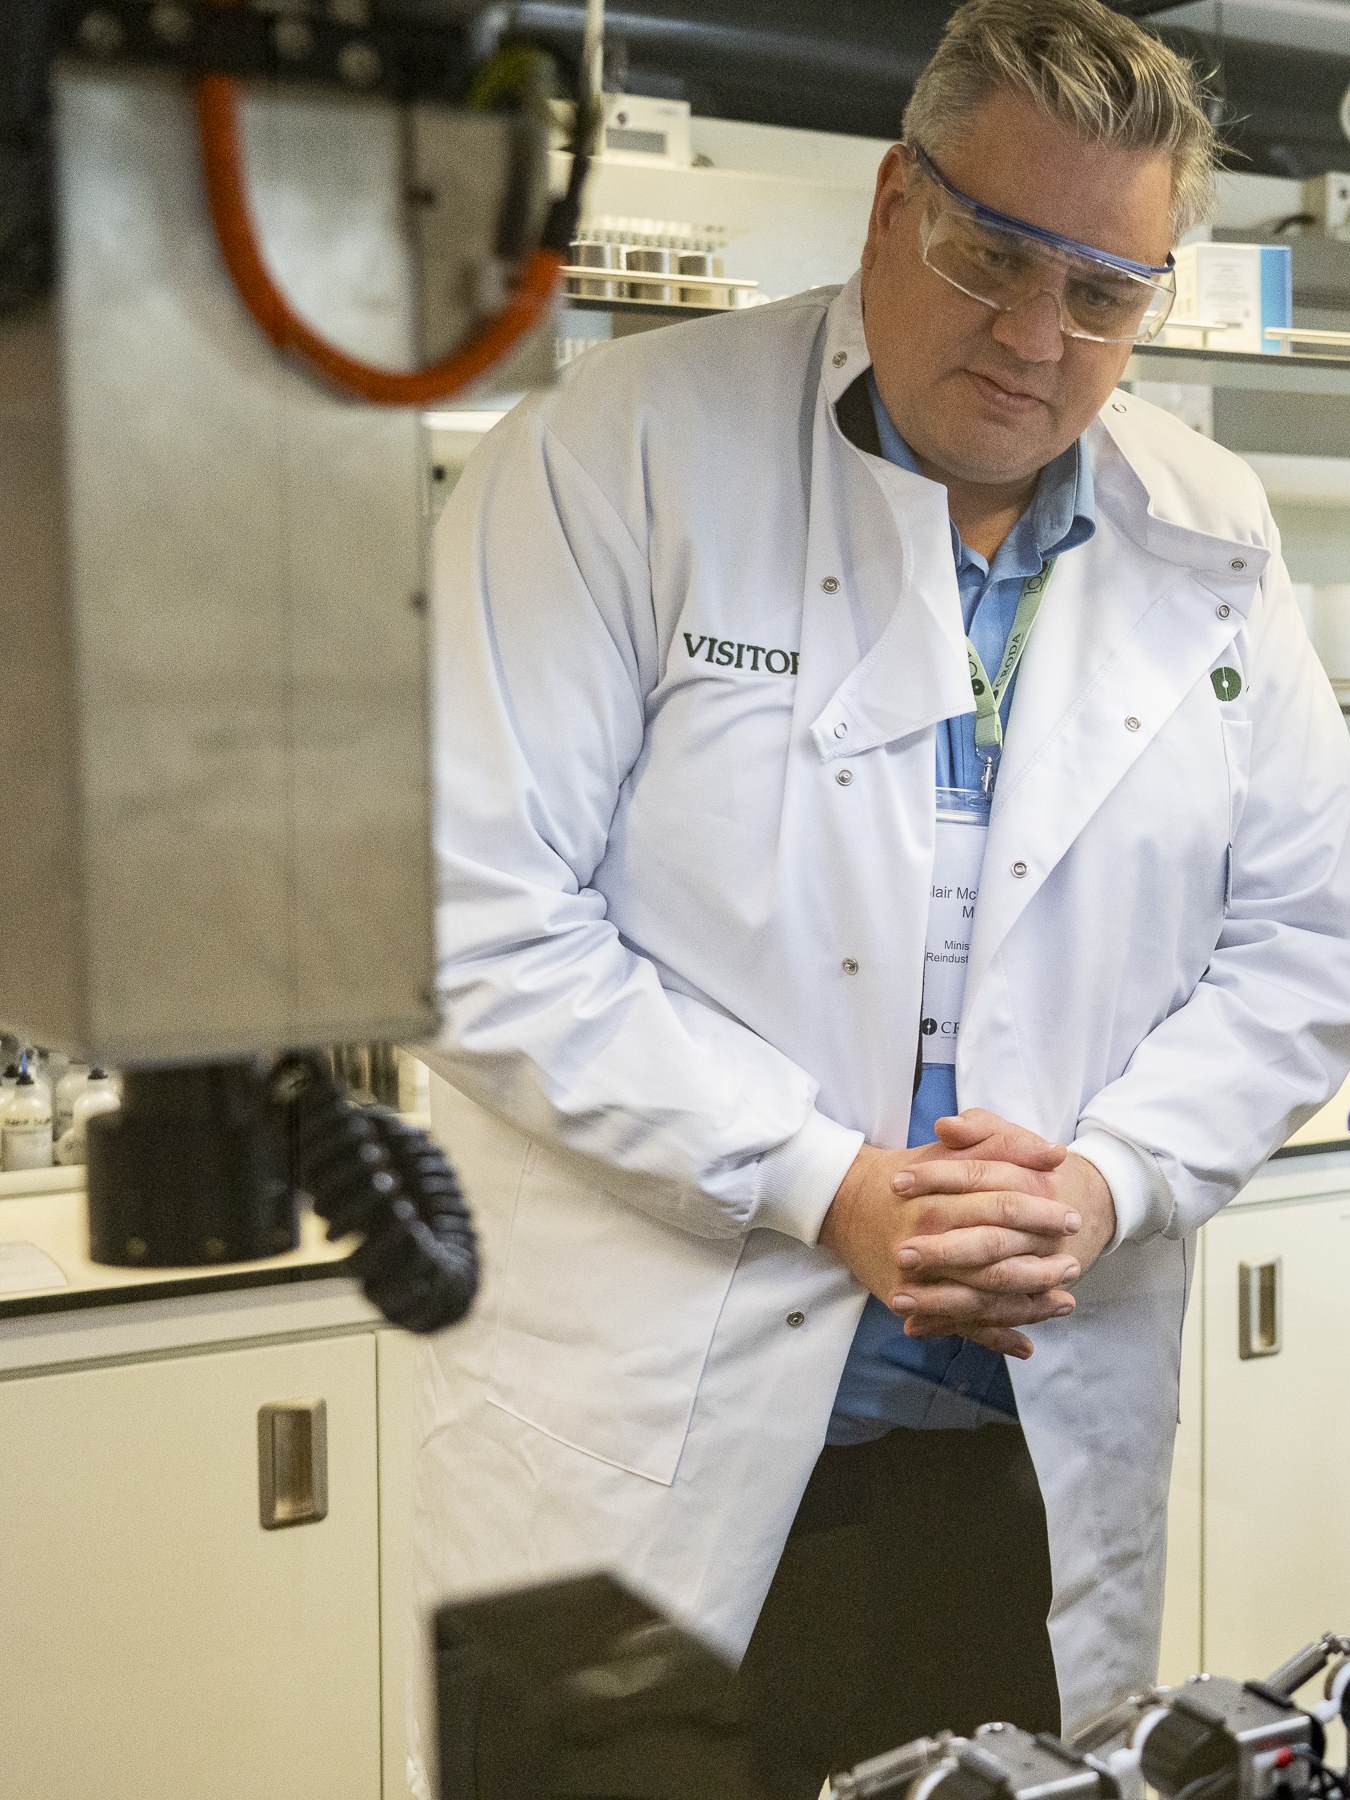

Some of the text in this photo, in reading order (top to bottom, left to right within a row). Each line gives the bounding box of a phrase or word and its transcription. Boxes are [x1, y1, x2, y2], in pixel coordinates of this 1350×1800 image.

[995, 633, 1021, 687] CRODA
[930, 885, 979, 901] lair Mc
[944, 940, 971, 951] Minis
